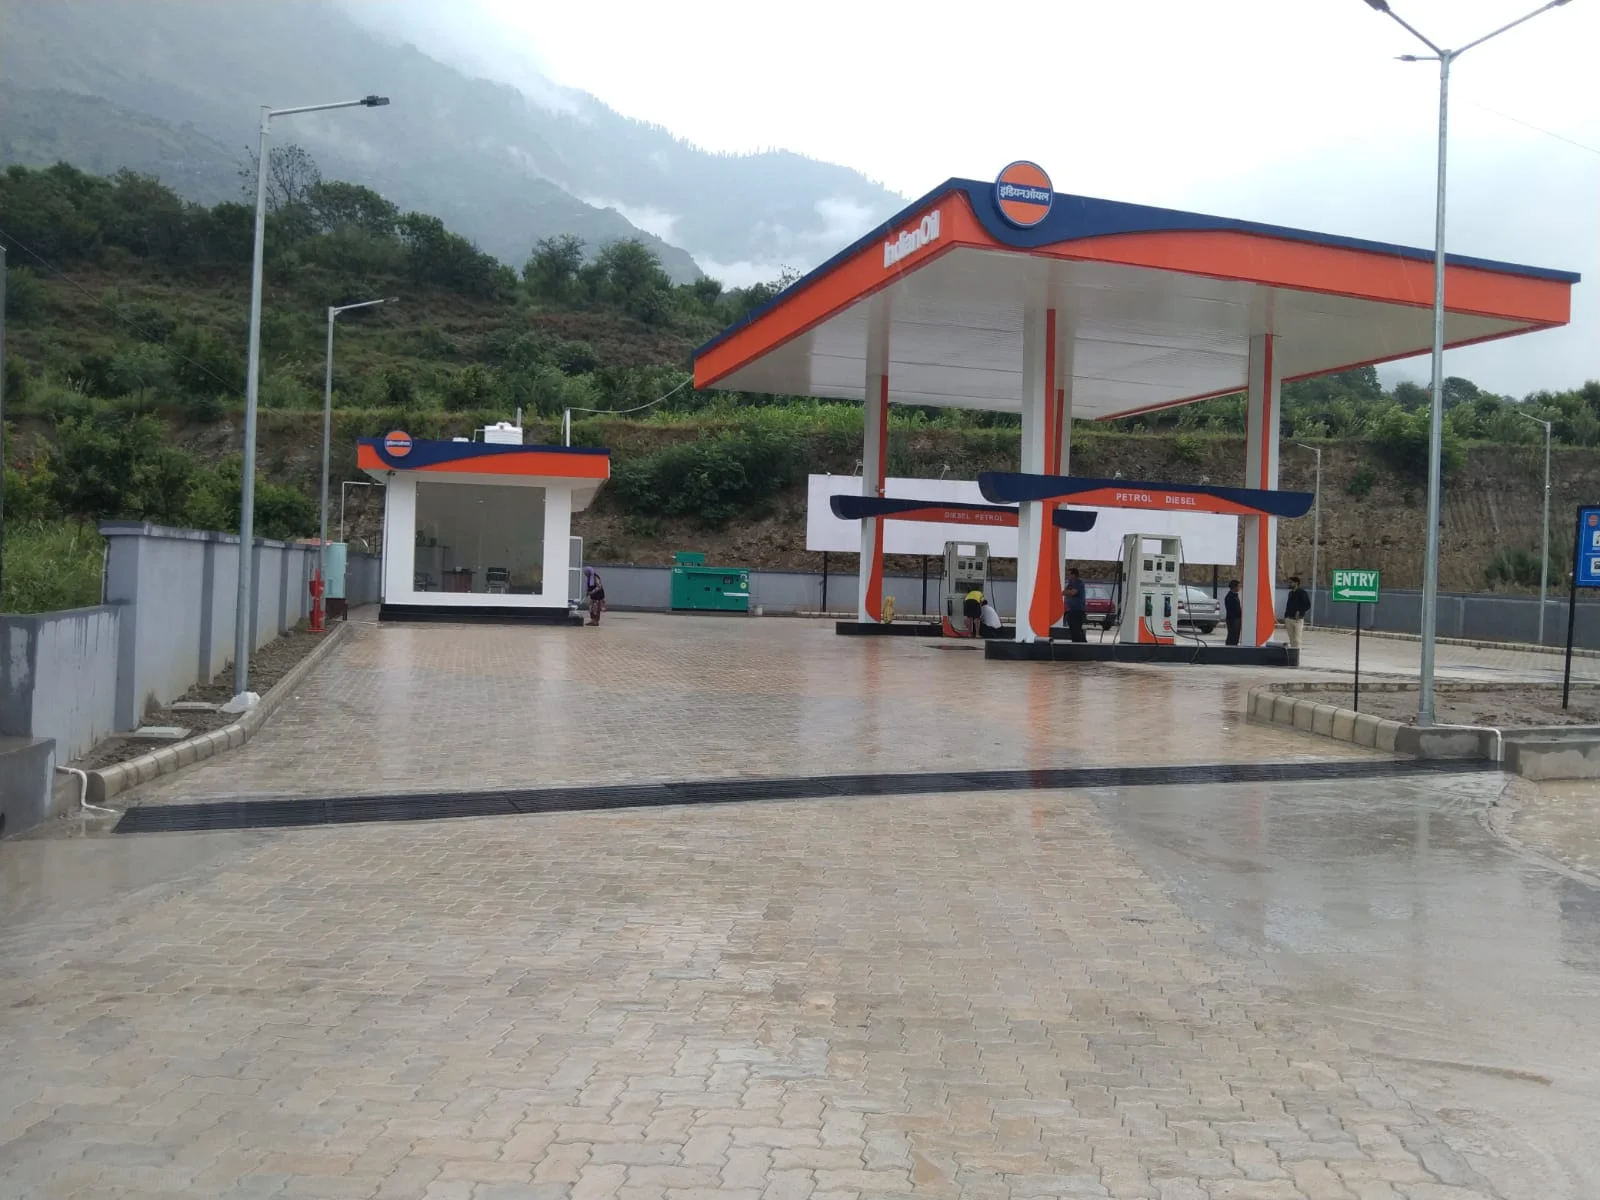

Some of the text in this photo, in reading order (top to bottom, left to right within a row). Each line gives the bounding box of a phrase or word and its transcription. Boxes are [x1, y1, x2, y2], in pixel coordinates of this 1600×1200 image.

[1116, 493, 1197, 506] PETROL DIESEL
[975, 513, 1004, 522] PETROL
[1335, 572, 1377, 587] ENTRY
